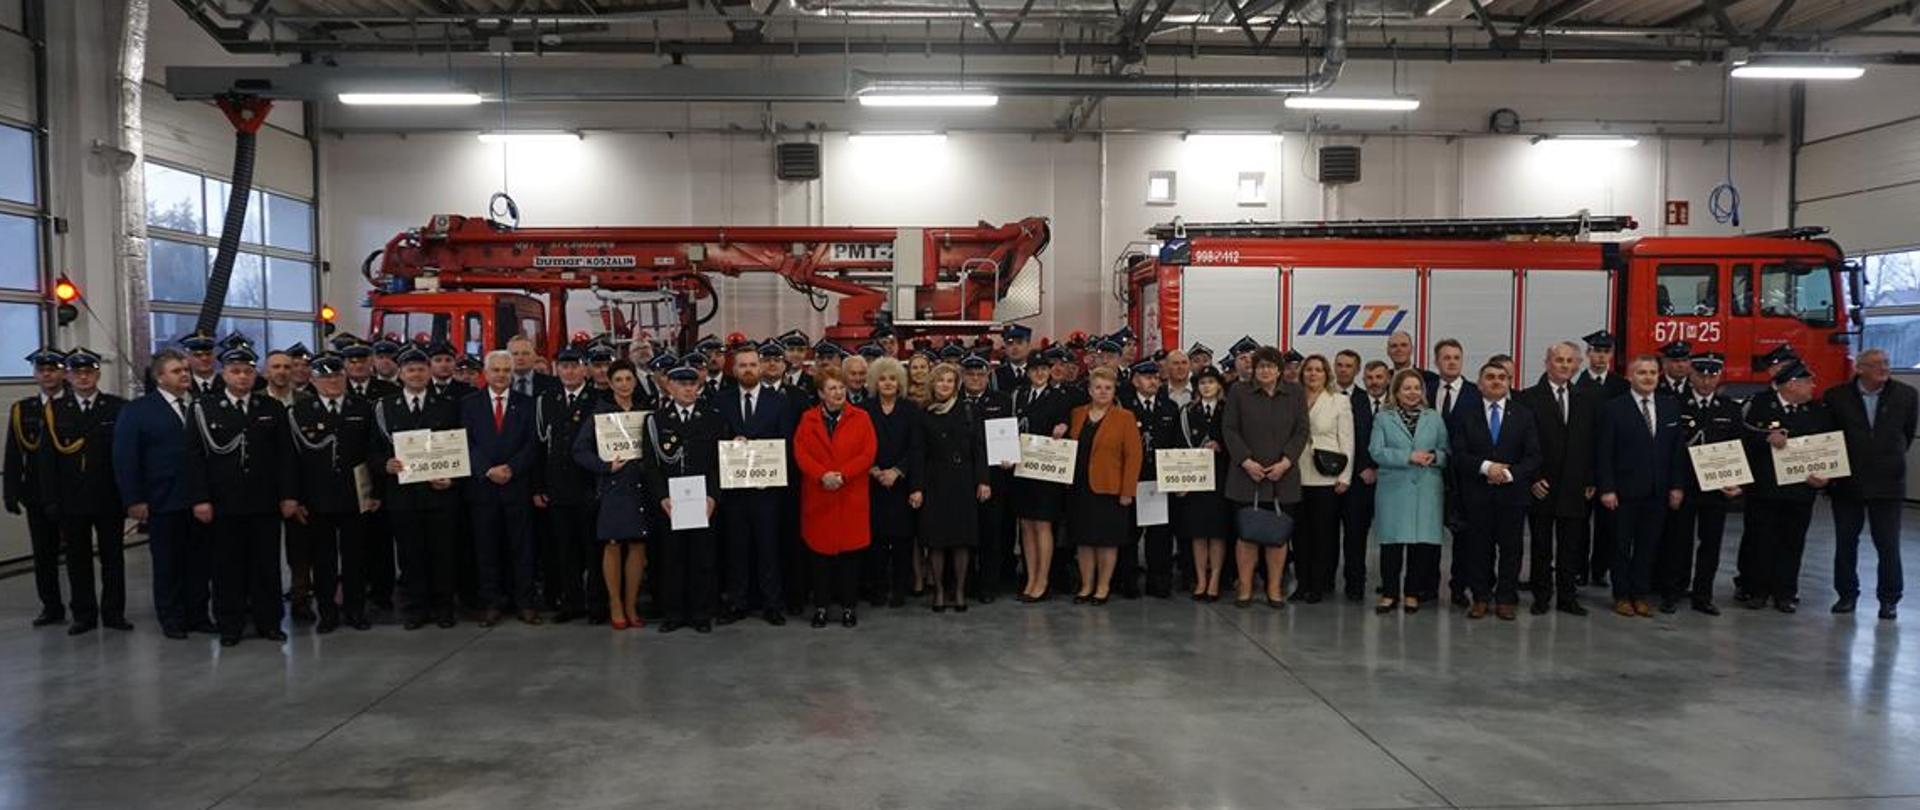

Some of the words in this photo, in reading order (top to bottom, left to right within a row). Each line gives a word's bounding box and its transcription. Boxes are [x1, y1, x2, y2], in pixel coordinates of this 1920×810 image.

[586, 257, 633, 266] KOSZALIN
[749, 468, 766, 478] 000
[1041, 463, 1056, 473] 000
[1786, 464, 1804, 475] 950
[1807, 462, 1826, 472] 000
[1181, 475, 1196, 483] 000
